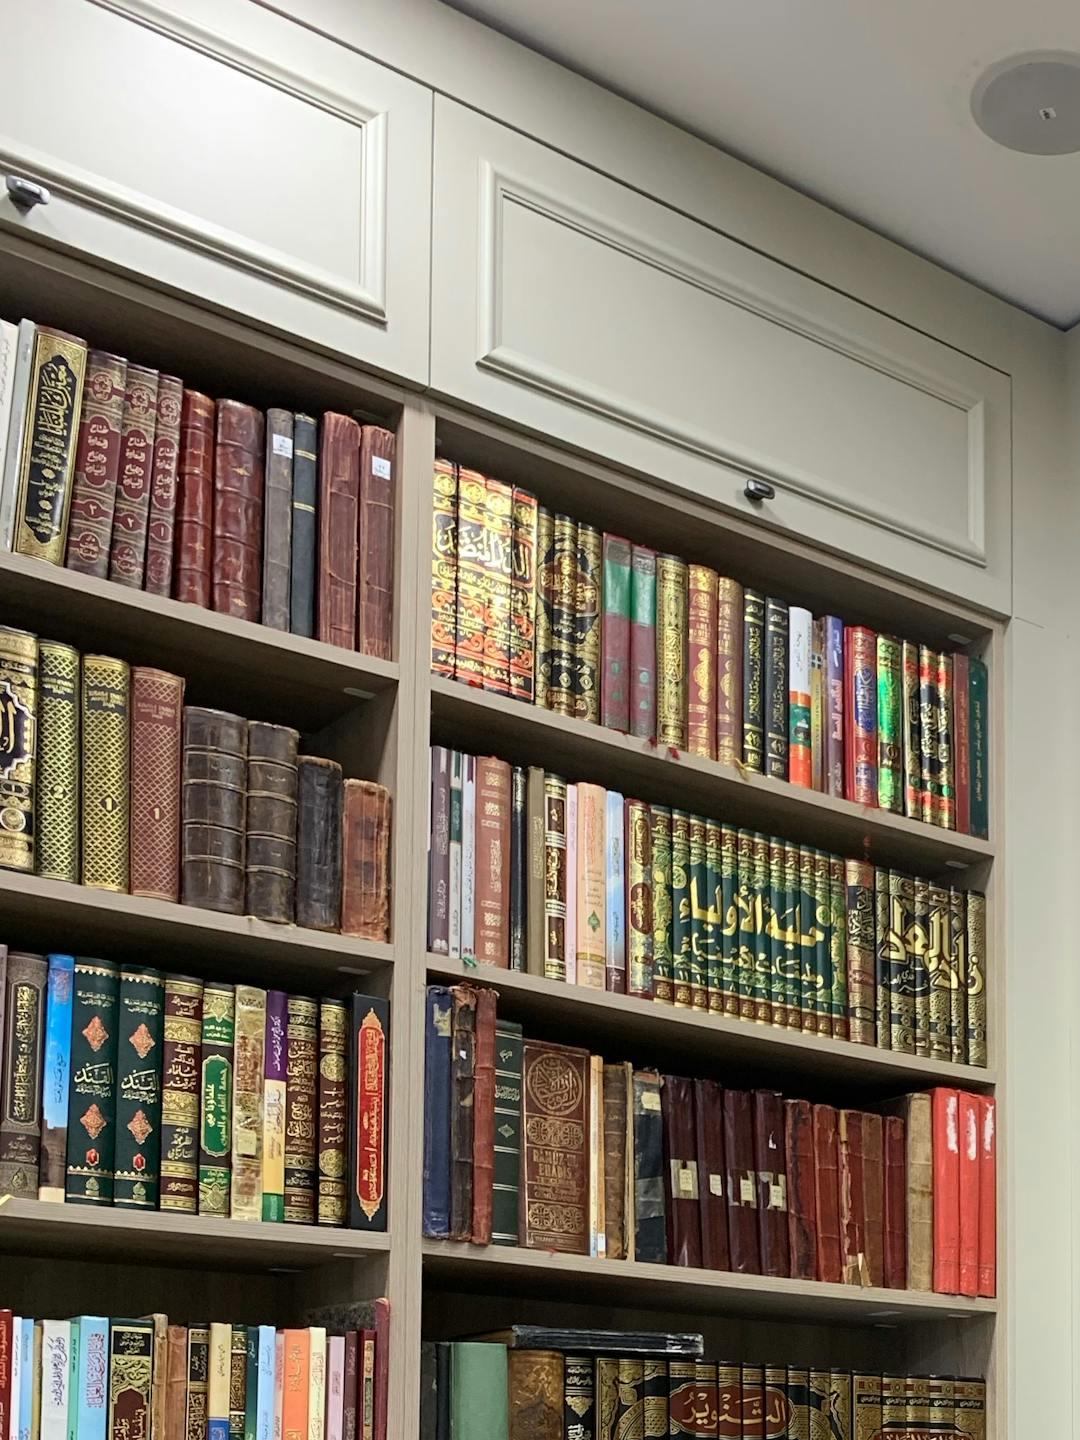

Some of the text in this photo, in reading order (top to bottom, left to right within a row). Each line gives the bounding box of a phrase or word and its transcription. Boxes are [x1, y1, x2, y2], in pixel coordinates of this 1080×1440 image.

[53, 786, 64, 798] 2
[105, 798, 112, 810] 1
[154, 808, 160, 819] 1
[679, 876, 826, 949] حلية الأولياء
[681, 1391, 787, 1430] التنوير
